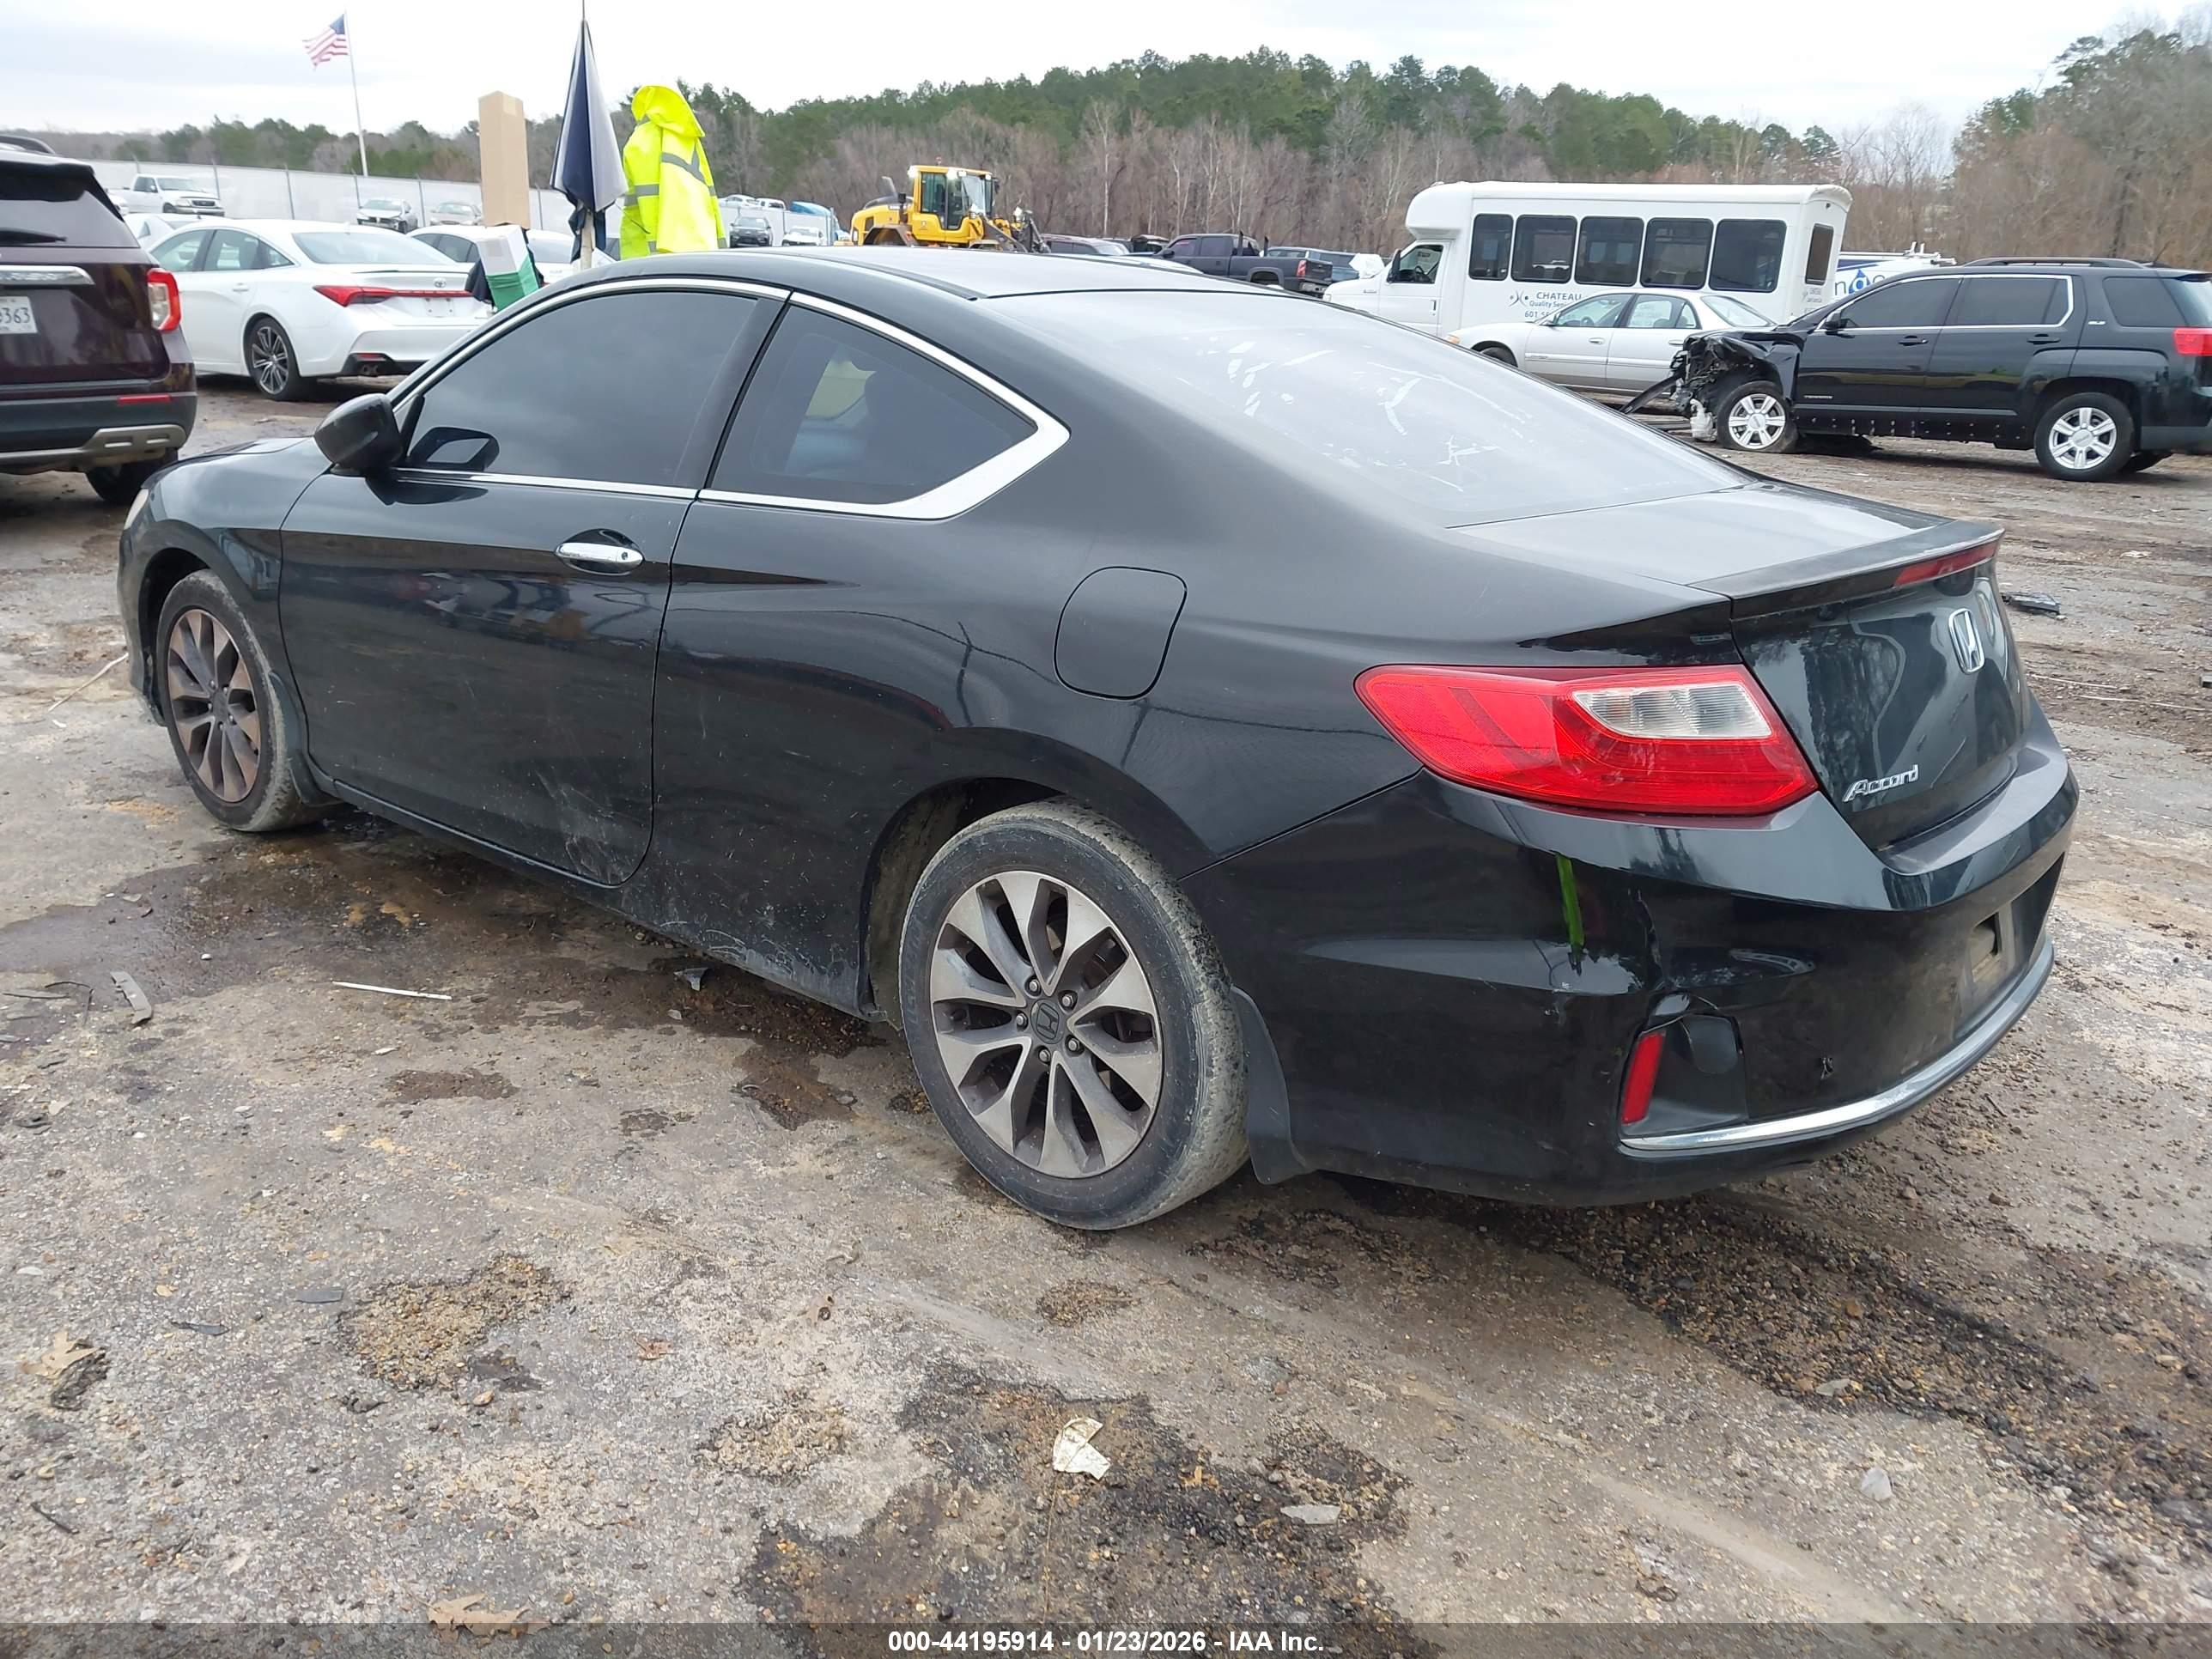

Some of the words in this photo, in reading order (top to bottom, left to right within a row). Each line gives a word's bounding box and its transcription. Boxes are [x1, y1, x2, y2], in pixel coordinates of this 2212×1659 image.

[1536, 291, 1582, 301] CHATEAU
[1529, 300, 1553, 308] Quality
[1842, 763, 1919, 803] Accord
